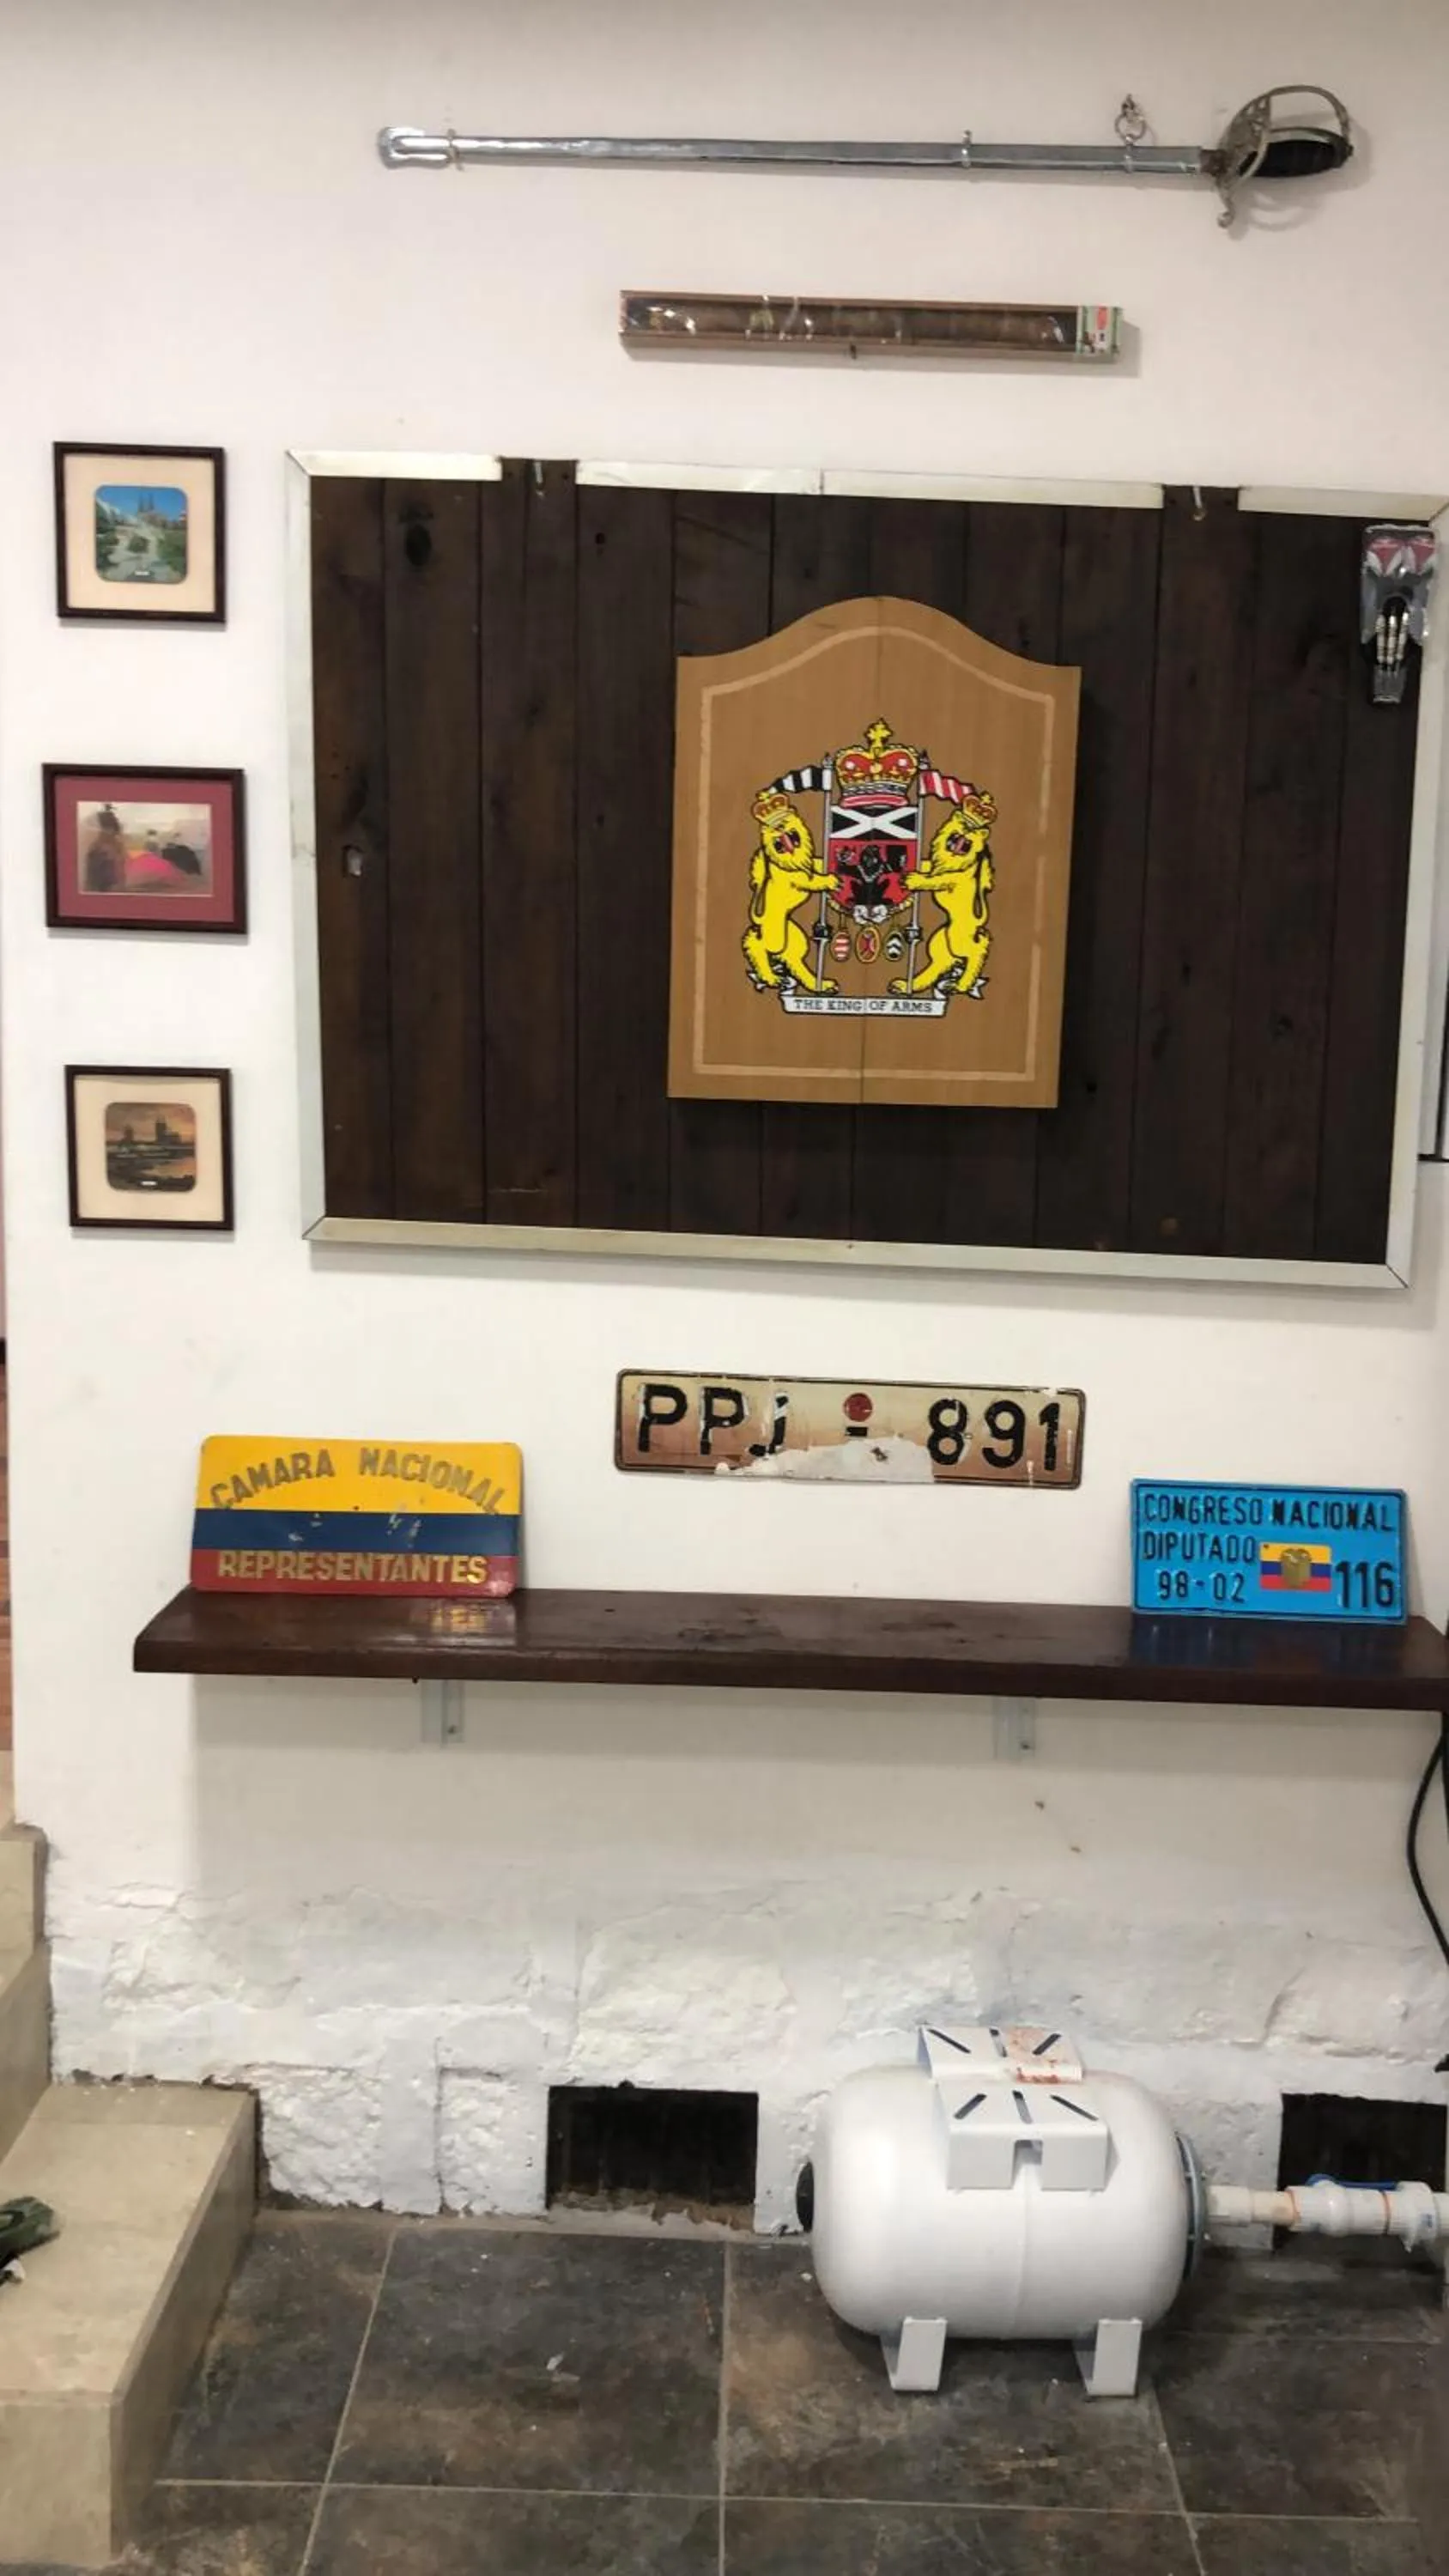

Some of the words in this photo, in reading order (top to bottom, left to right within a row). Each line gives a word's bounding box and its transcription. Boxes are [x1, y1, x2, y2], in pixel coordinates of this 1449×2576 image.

[794, 999, 823, 1011] THE
[827, 1000, 862, 1012] KING
[869, 1001, 887, 1011] OF
[892, 1002, 932, 1013] ARMS
[926, 1398, 1061, 1471] 891
[209, 1449, 336, 1510] CAMARA
[359, 1447, 506, 1515] NACIONAL
[1143, 1493, 1263, 1525] CONGRESO
[1270, 1499, 1396, 1532] NACIONAL
[218, 1550, 489, 1584] REPRESENTANTES
[1142, 1531, 1257, 1564] DIPUTADO
[1335, 1560, 1396, 1608] 116
